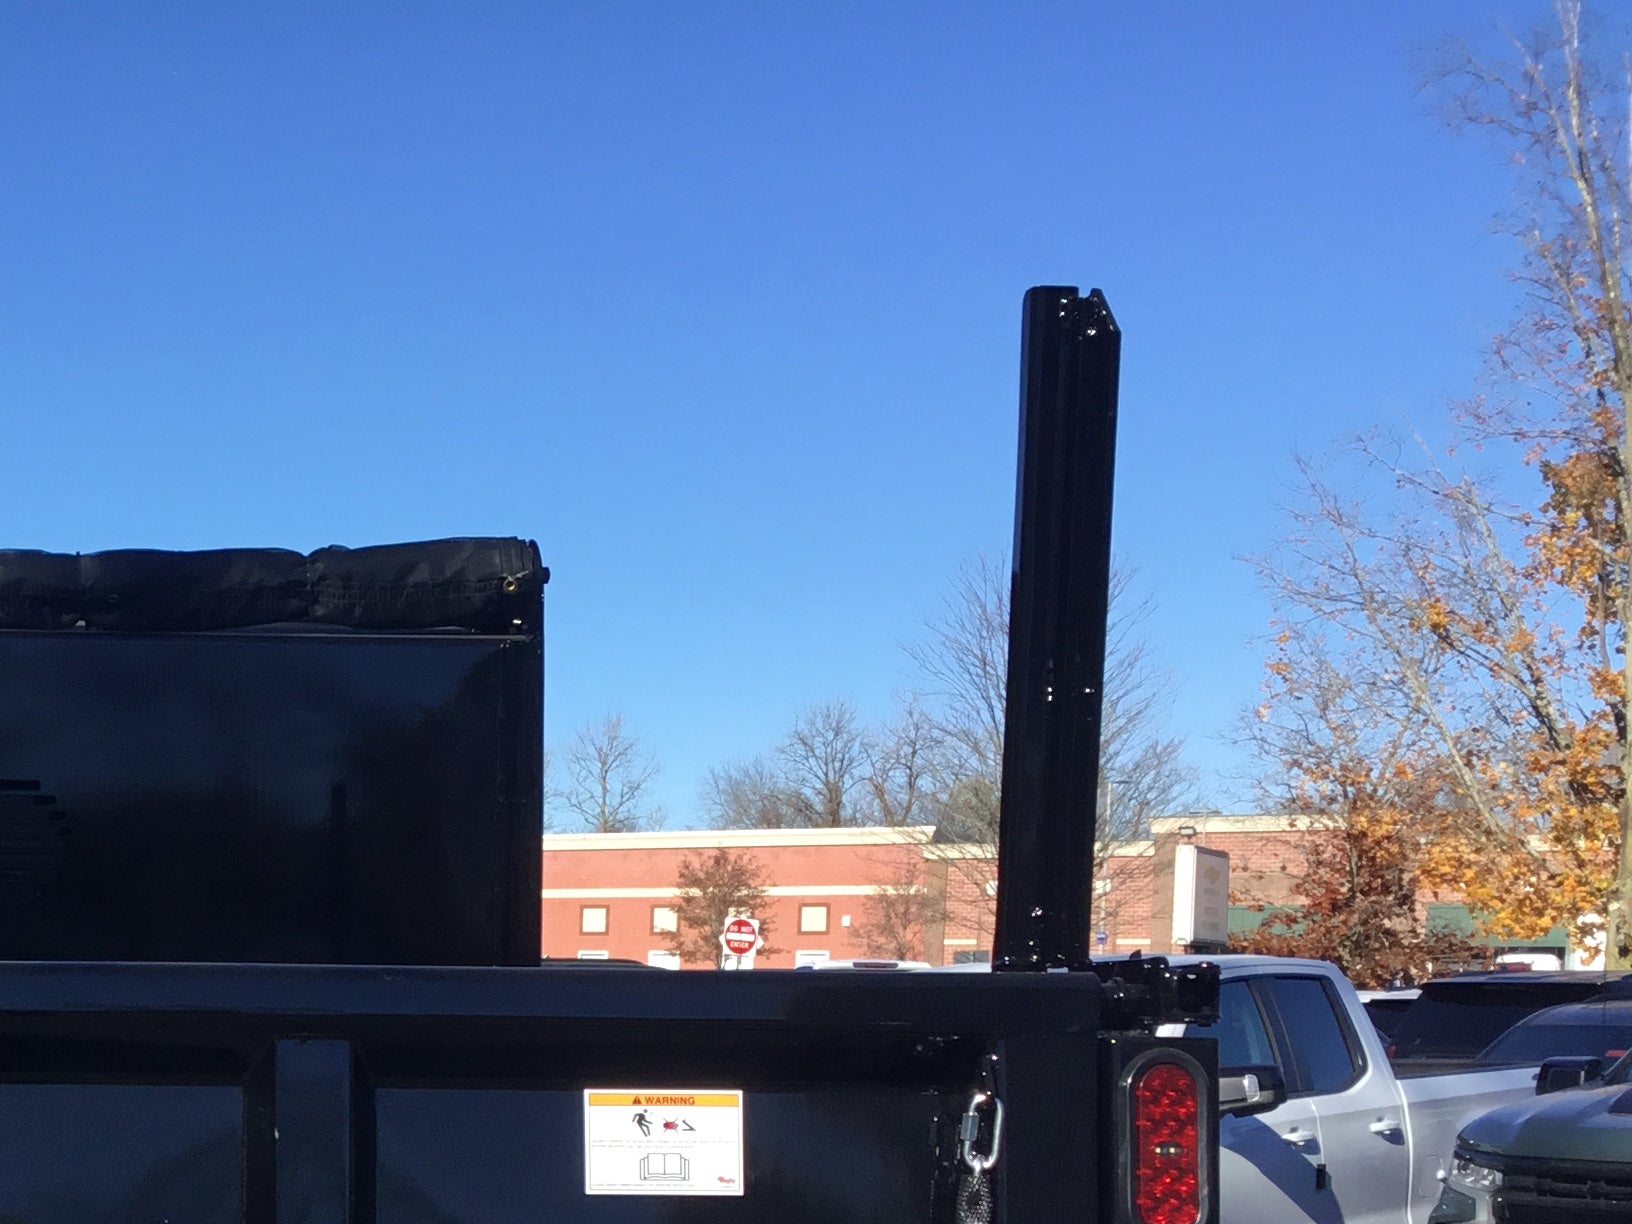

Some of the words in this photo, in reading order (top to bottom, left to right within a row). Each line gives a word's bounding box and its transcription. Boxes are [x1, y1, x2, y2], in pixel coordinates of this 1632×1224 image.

[729, 924, 739, 932] DO
[729, 941, 749, 949] ENTER
[644, 1096, 696, 1106] WARNING
